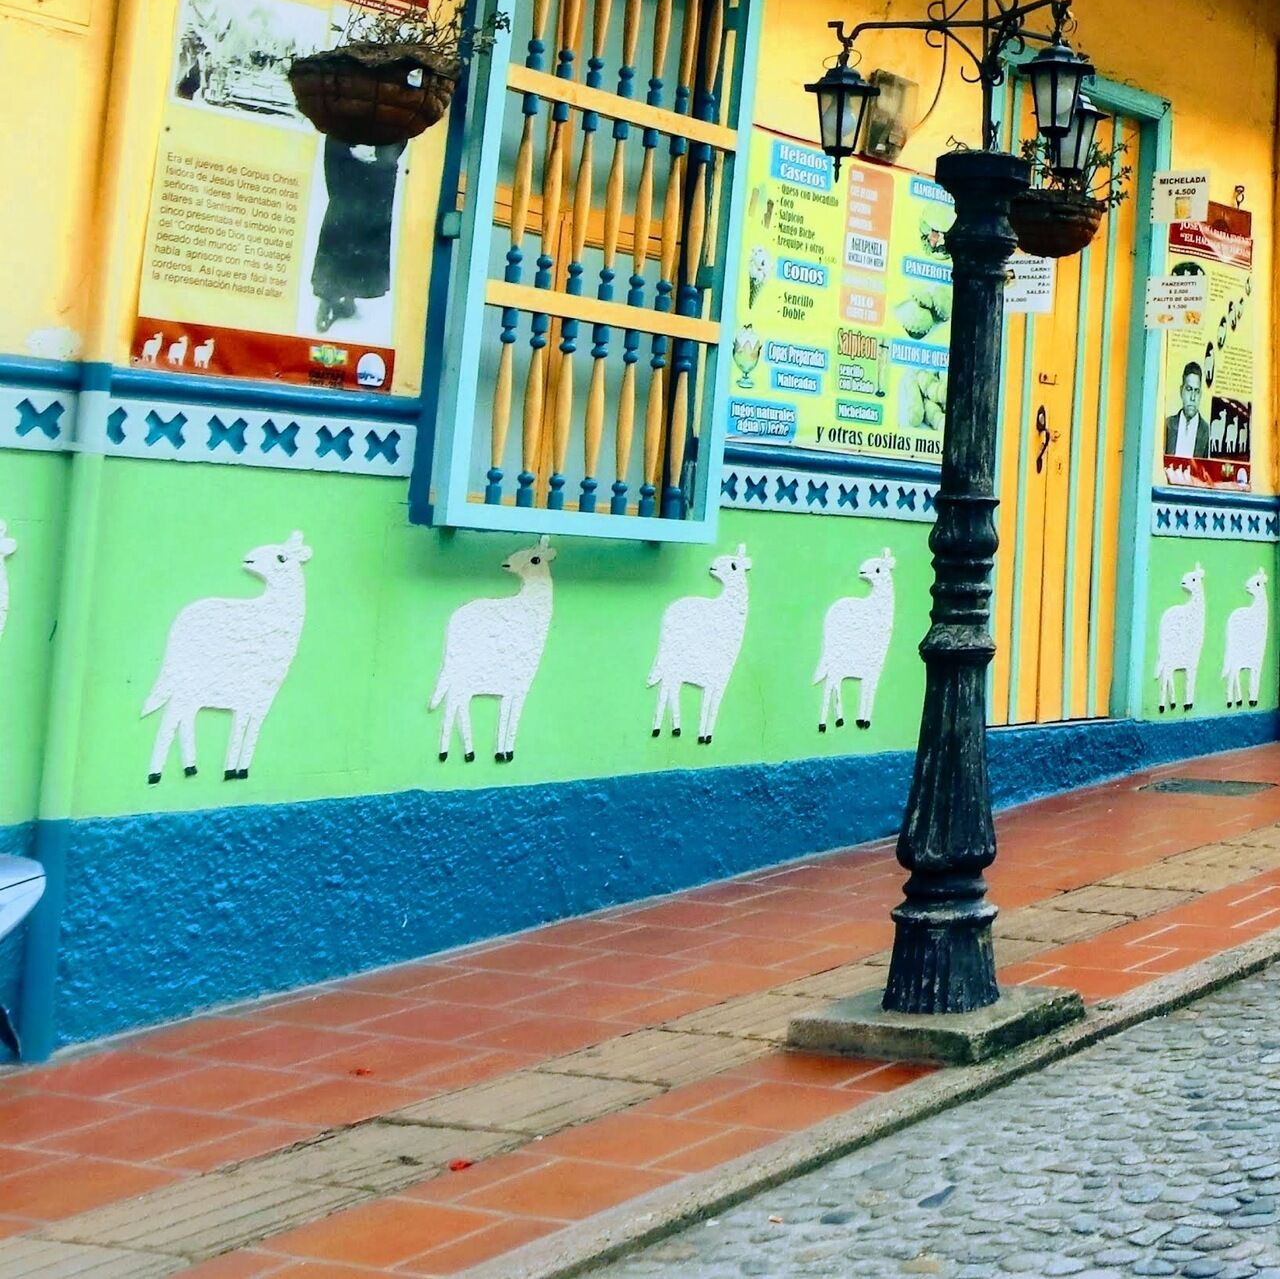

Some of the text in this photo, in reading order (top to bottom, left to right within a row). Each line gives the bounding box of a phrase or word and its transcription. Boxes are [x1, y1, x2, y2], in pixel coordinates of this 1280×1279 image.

[168, 152, 181, 163] Era
[185, 156, 192, 165] el
[195, 159, 223, 172] jueves
[226, 164, 237, 174] de
[241, 167, 269, 180] Corpus
[781, 145, 828, 170] Helados
[781, 163, 825, 188] Caseros
[1160, 176, 1206, 185] MICHELADA
[196, 172, 207, 181] de
[237, 180, 259, 192] Urrea
[263, 185, 276, 195] con
[279, 187, 298, 200] otras
[782, 184, 798, 197] Queso
[801, 191, 811, 200] con
[160, 206, 183, 216] cinco
[162, 192, 192, 205] altares
[196, 198, 203, 206] al
[252, 208, 269, 219] Uno
[271, 212, 281, 222] de
[284, 214, 295, 224] los
[236, 192, 281, 208] levantaban
[286, 201, 297, 212] los
[781, 197, 794, 209] Coco
[780, 209, 804, 224] Salpicon
[216, 228, 226, 237] de
[228, 228, 245, 240] Dios
[247, 234, 261, 245] que
[264, 236, 283, 248] quita
[286, 240, 293, 249] el
[779, 222, 797, 236] Mango
[157, 232, 190, 245] pecado
[193, 236, 206, 246] del
[245, 245, 255, 256] En
[810, 244, 824, 255] otros
[225, 256, 240, 265] con
[263, 262, 273, 271] de
[276, 264, 286, 273] 50
[784, 261, 824, 285] Conos
[906, 260, 952, 281] PANZEROTT
[152, 270, 160, 280] la
[232, 284, 255, 295] hasta
[256, 287, 263, 296] el
[216, 269, 231, 280] que
[233, 271, 247, 280] era
[784, 292, 814, 308] Sencillo
[782, 306, 806, 320] Doble
[838, 328, 877, 360] Salpicon
[768, 342, 825, 368] Copas Preparadas
[893, 344, 949, 367] PALITOS DE QUES
[777, 372, 817, 391] Malteadas
[757, 407, 794, 422] naturales
[838, 404, 879, 421] Micheladas
[737, 419, 789, 435] agua y leche
[815, 426, 824, 443] y
[828, 426, 862, 446] otras
[867, 432, 911, 451] cositas
